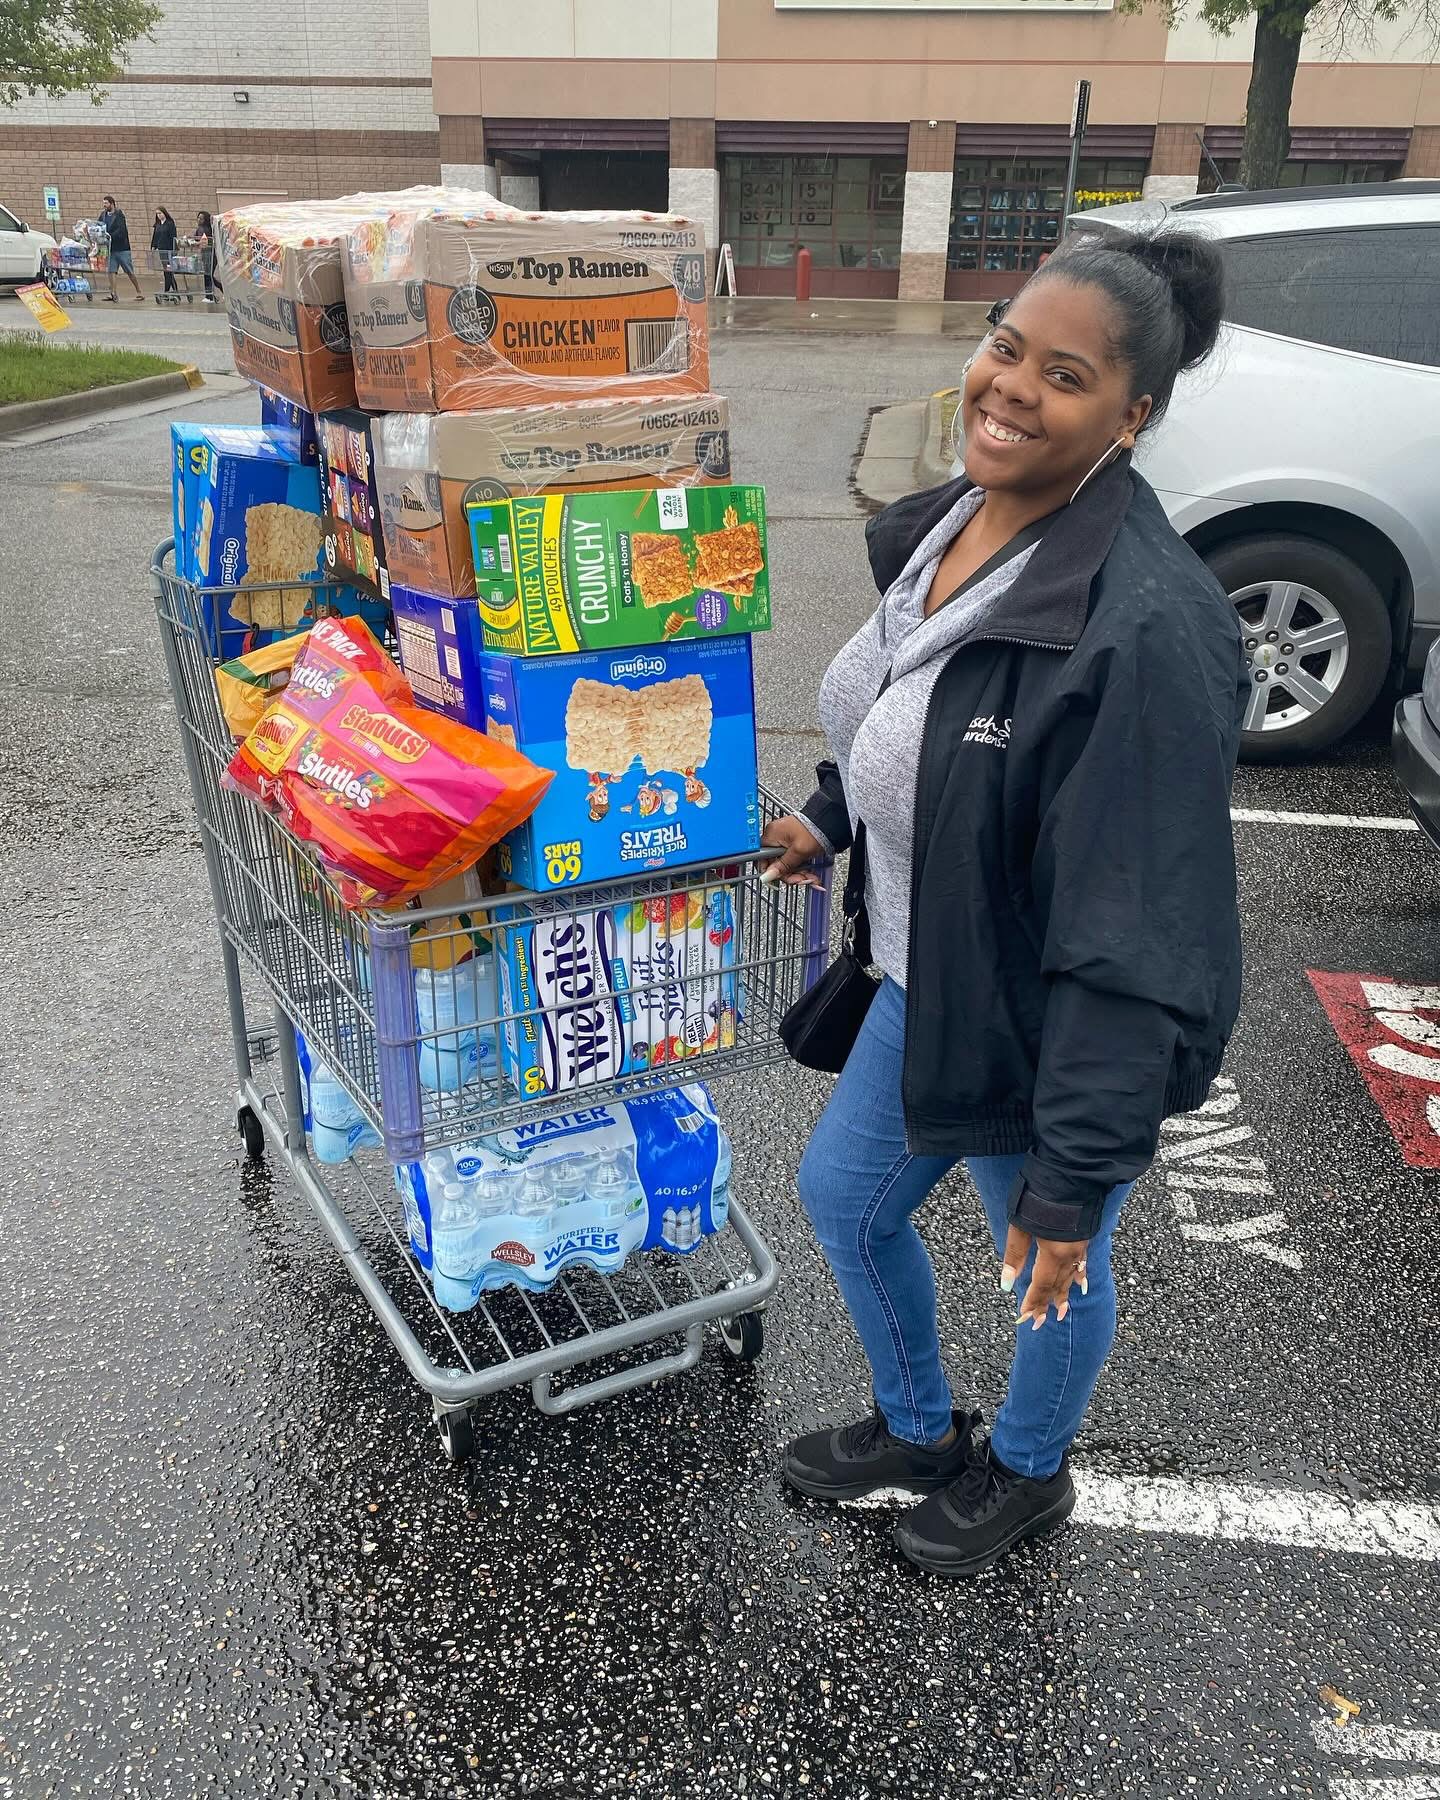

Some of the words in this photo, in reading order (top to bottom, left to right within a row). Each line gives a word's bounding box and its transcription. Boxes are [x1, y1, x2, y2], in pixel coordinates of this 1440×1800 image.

[619, 232, 696, 248] 70662-02413
[488, 262, 512, 274] NISSIN
[518, 257, 563, 286] Top
[568, 256, 650, 279] Ramen
[683, 259, 701, 283] 48
[411, 286, 421, 305] 48
[360, 313, 375, 332] Top
[375, 311, 408, 327] Ramen
[503, 319, 595, 349] CHICKEN
[597, 318, 621, 333] FLAVOR
[369, 351, 405, 377] CHICKEN
[523, 350, 550, 365] NATURAL
[551, 350, 564, 363] AND
[565, 348, 595, 362] ARTIFICIAL
[595, 346, 621, 360] FLAVORS
[638, 409, 719, 430] 70662-02413
[534, 446, 582, 472] Top
[586, 441, 670, 463] Ramen
[318, 453, 326, 489] BOLD
[321, 492, 329, 517] MIX
[475, 488, 493, 502] NO
[662, 495, 673, 517] 22g
[516, 504, 544, 574] VALLEY
[620, 534, 629, 564] Honey
[223, 539, 238, 584] Original
[544, 537, 560, 598] POUCHES
[572, 519, 610, 624] CRUNCHY
[624, 584, 632, 603] Oats
[523, 574, 558, 648] NATURE
[550, 600, 563, 613] 49
[327, 630, 368, 659] PACK
[613, 658, 663, 678] Original
[343, 706, 429, 757] Starburst
[968, 714, 999, 732] sch
[962, 729, 1005, 748] ardens
[297, 752, 373, 808] Skittles
[622, 823, 685, 849] TREATS
[665, 838, 687, 853] RICE
[544, 841, 581, 860] BARS
[620, 844, 666, 861] KRISPIES
[547, 855, 581, 884] 60
[515, 937, 530, 978] Ingredient!
[613, 963, 626, 989] FRUIT
[632, 954, 663, 1012] Fruit
[598, 982, 612, 1015] FARER
[523, 1017, 537, 1042] Fruit
[686, 1022, 697, 1044] REAL
[524, 1065, 545, 1094] 90
[665, 1091, 679, 1100] OZ
[513, 1105, 610, 1139] WATER
[654, 1187, 671, 1196] 40
[676, 1184, 698, 1196] 16.9
[557, 1226, 605, 1243] PURIFIED
[492, 1249, 533, 1262] WELLSLEY
[543, 1233, 619, 1262] WATER
